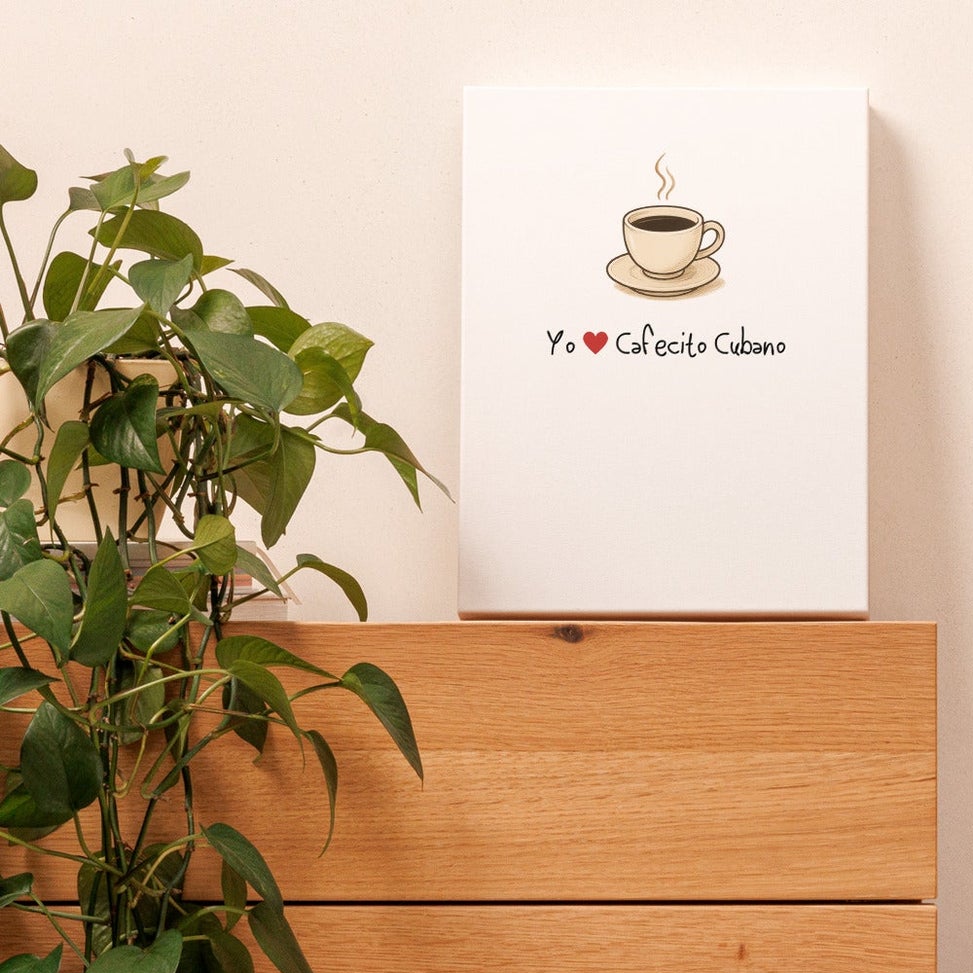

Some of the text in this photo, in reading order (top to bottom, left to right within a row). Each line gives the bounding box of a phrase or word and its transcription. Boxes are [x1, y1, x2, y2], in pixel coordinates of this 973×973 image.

[546, 323, 787, 358] Yo Cafecito Cubano
